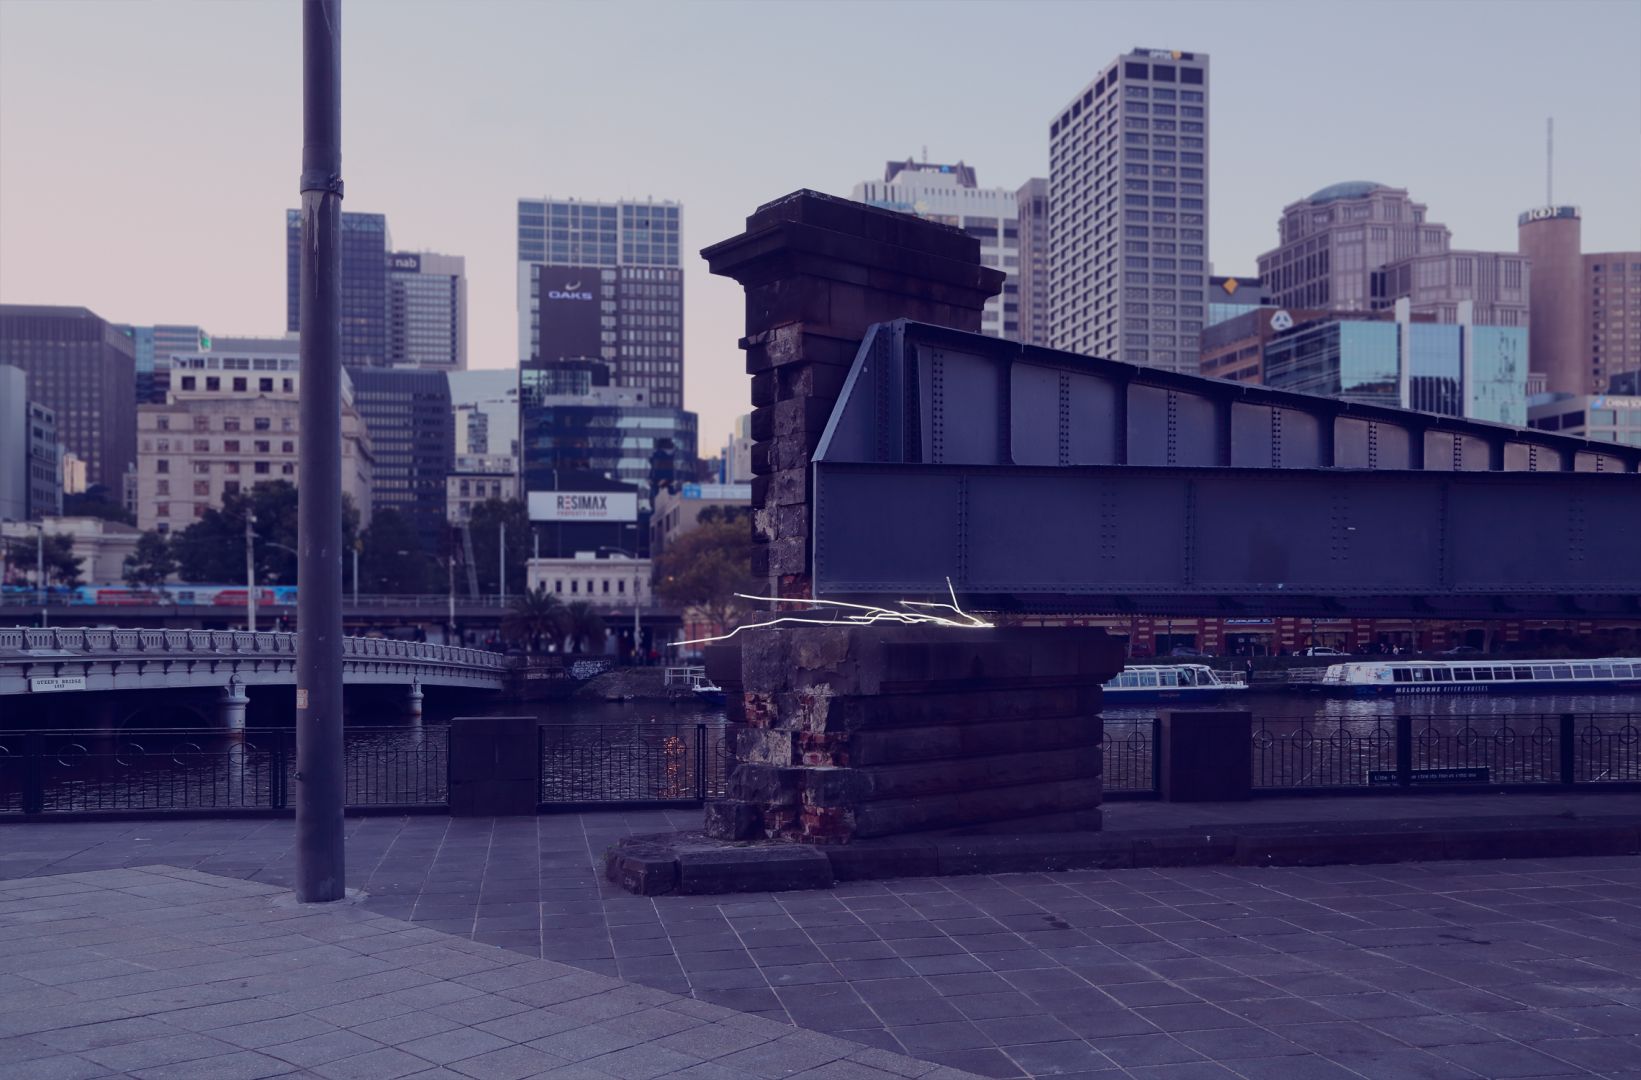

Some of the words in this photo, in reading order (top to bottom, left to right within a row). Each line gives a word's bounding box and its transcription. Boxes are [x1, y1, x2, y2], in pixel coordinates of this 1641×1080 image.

[395, 257, 417, 268] nab
[548, 291, 592, 300] OAKS
[557, 495, 608, 510] RESIMAX
